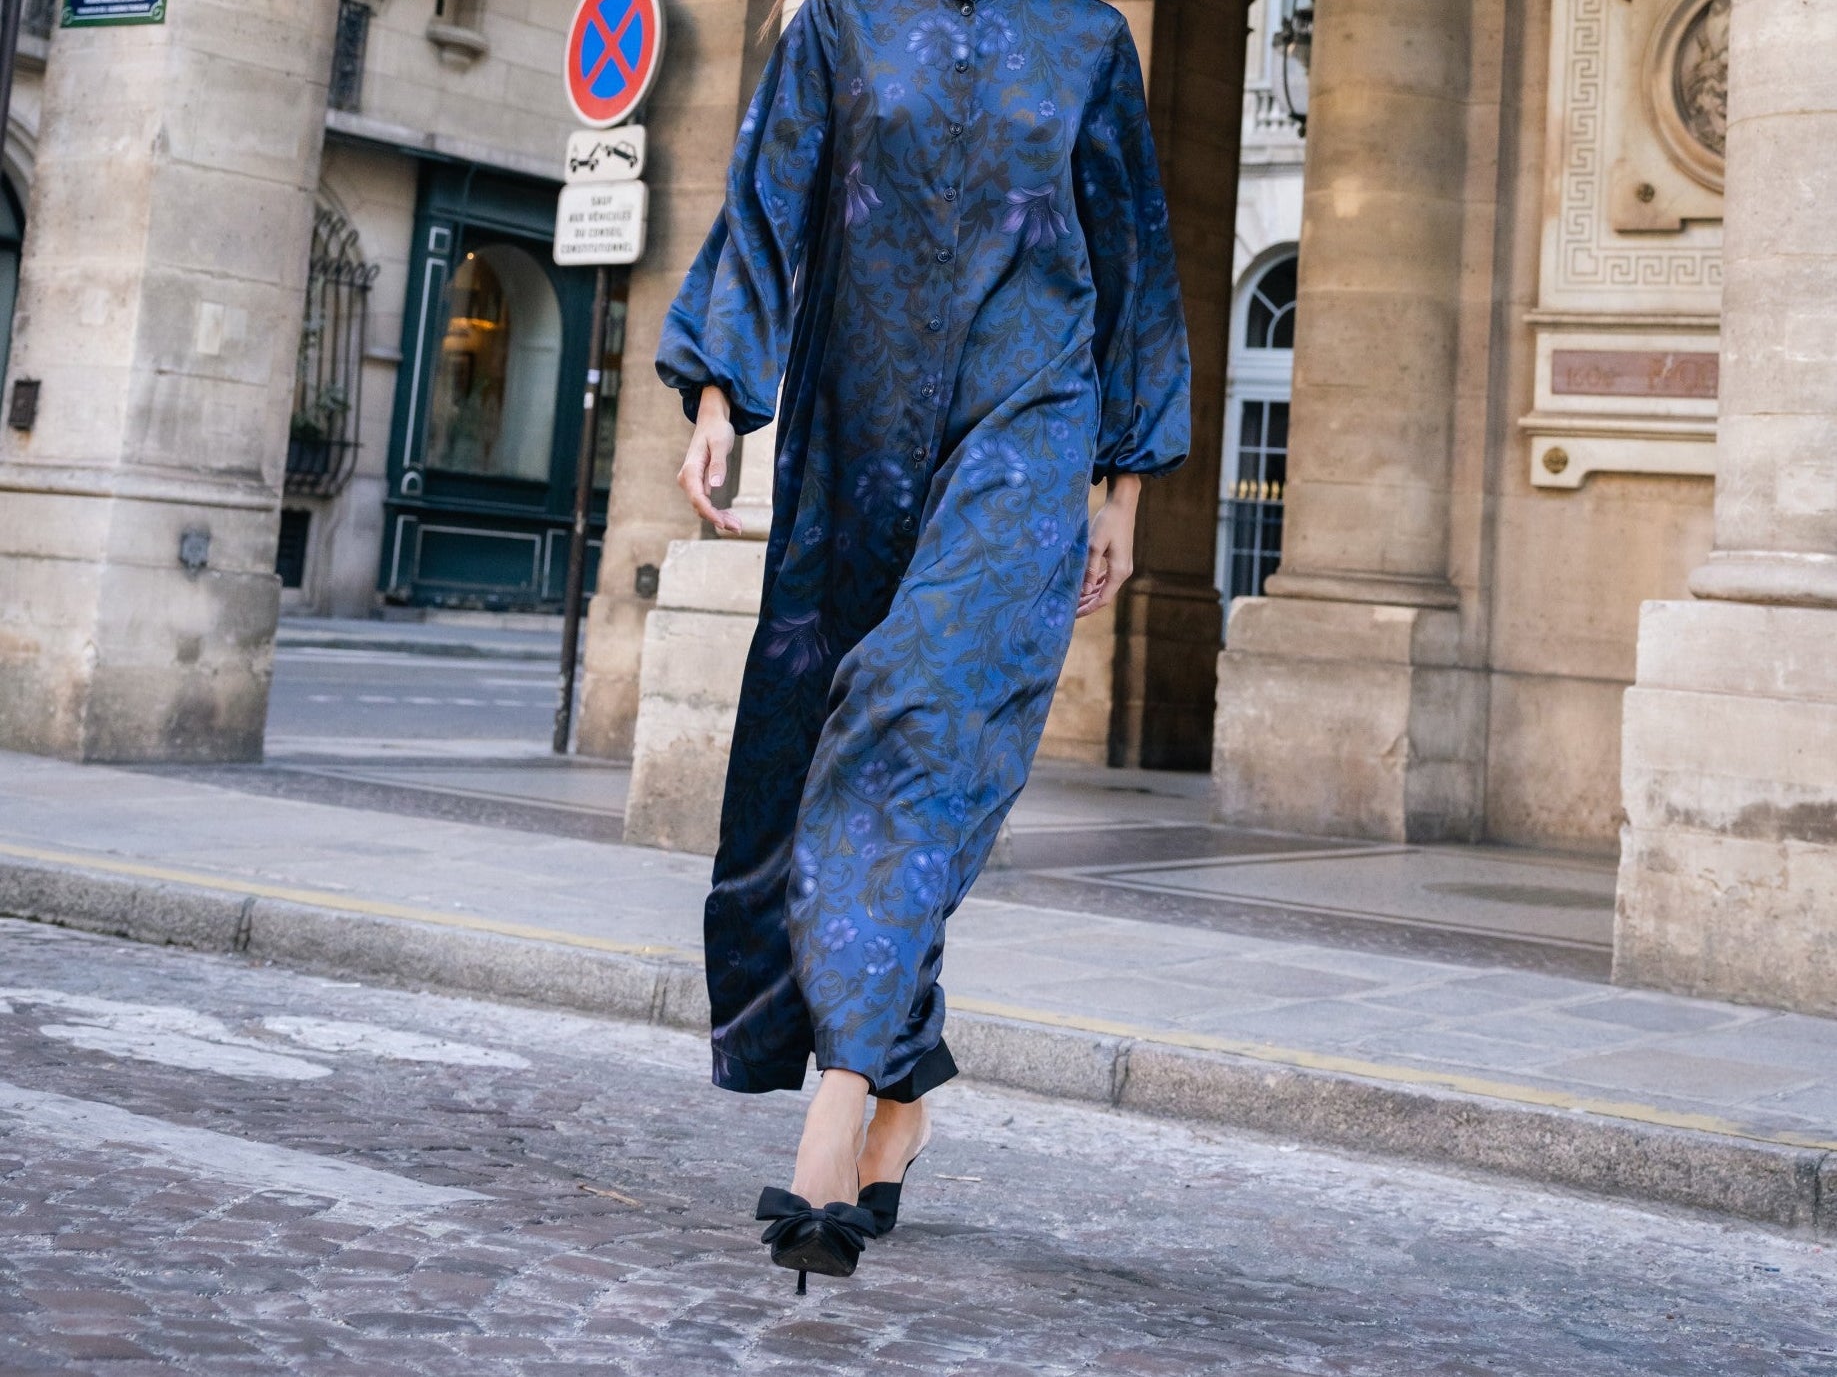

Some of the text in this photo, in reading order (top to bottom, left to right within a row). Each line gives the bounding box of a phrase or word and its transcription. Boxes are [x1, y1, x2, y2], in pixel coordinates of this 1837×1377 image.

[590, 195, 613, 206] SAUF
[568, 213, 585, 223] AUX
[575, 228, 585, 238] DU
